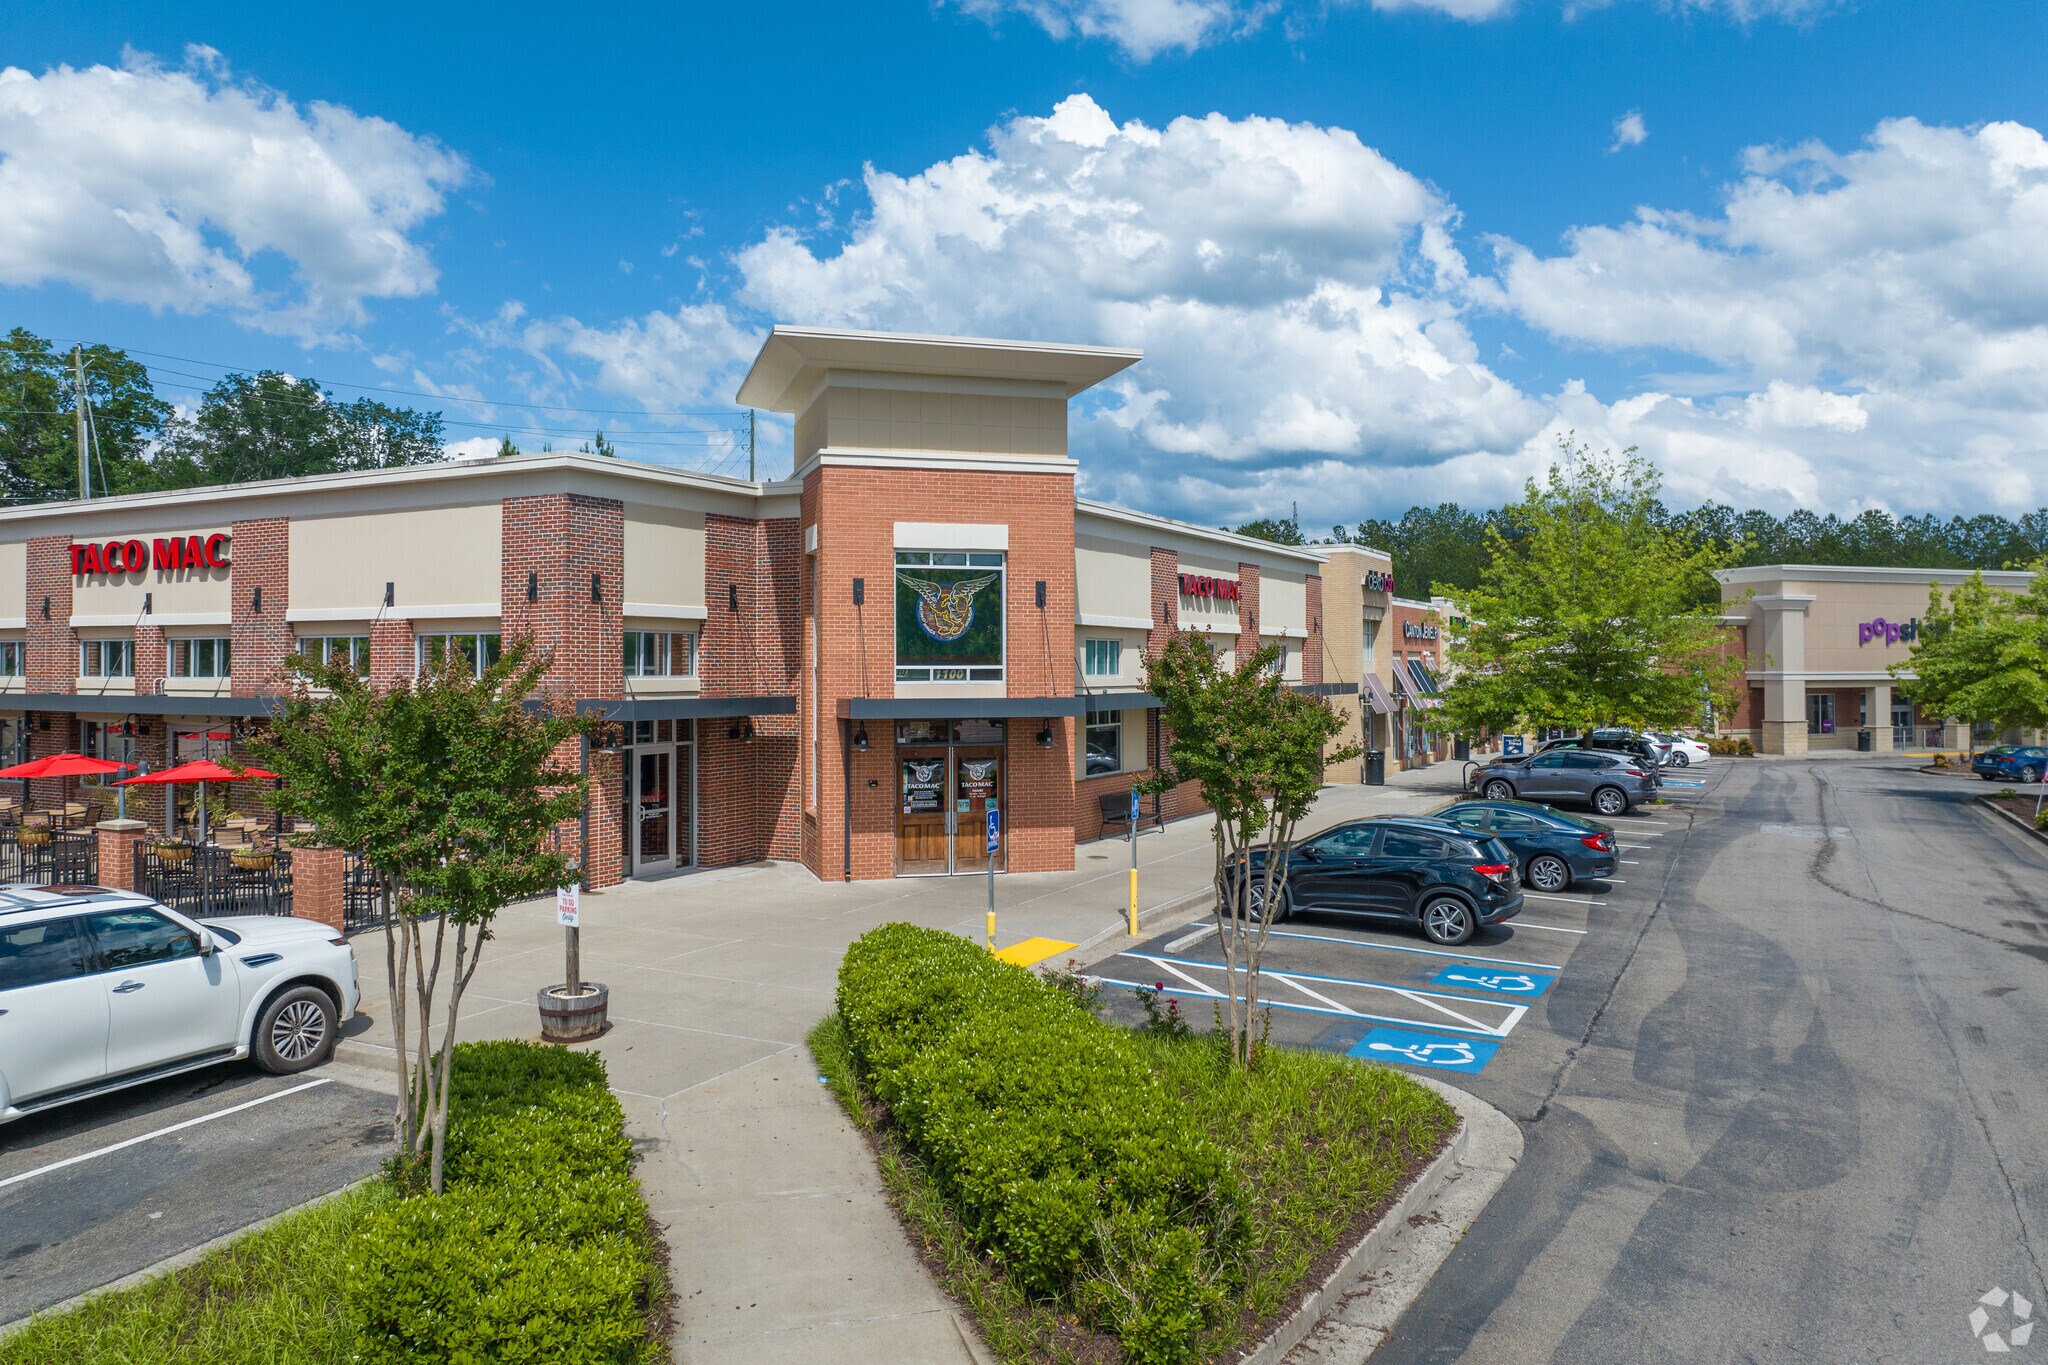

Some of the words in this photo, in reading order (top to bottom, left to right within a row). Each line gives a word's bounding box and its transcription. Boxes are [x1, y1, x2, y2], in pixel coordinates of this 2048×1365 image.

[68, 539, 145, 575] TACO
[153, 533, 230, 570] MAC
[1181, 573, 1214, 597] TACO
[1217, 578, 1242, 600] MAC
[935, 670, 964, 679] 1100
[560, 905, 577, 914] PARKING
[562, 913, 574, 922] Only
